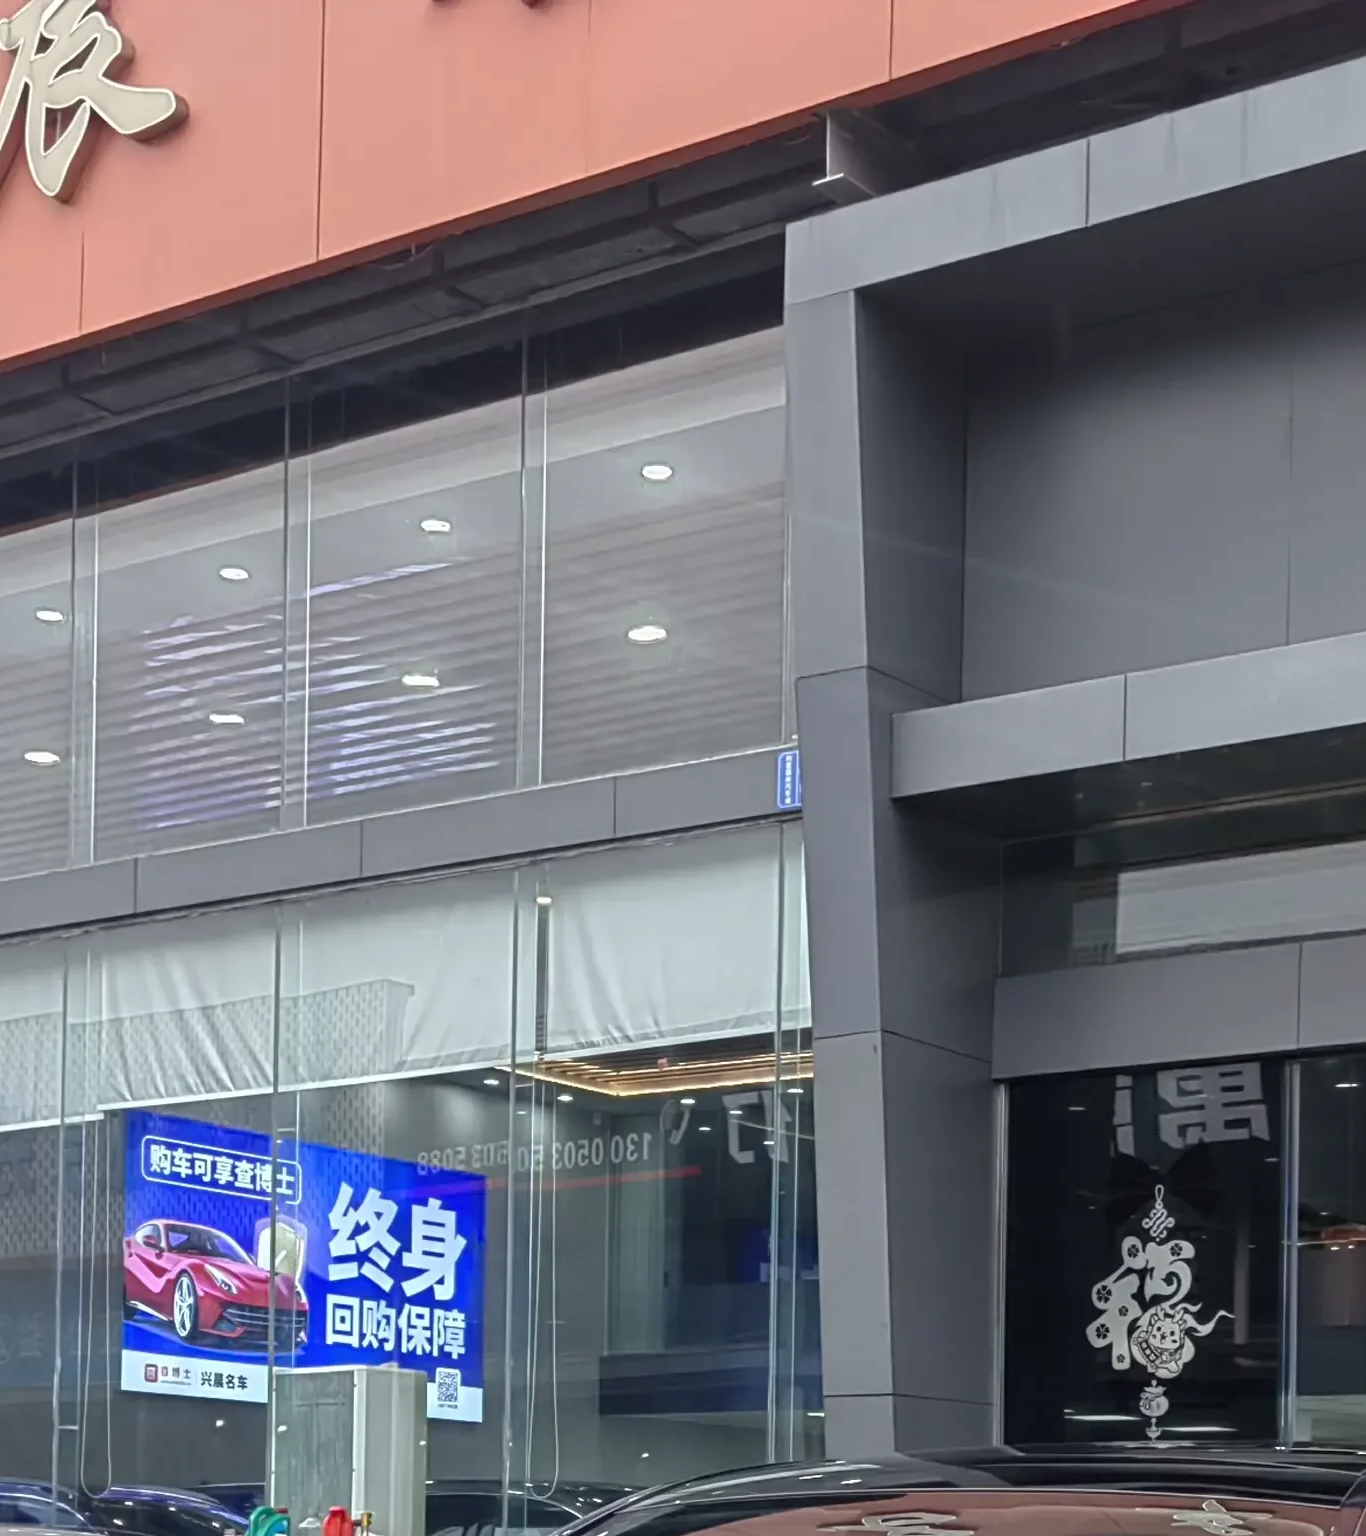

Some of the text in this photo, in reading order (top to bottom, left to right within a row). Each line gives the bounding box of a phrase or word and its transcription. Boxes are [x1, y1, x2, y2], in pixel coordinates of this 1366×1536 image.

[149, 1143, 296, 1196] 购车可享查博士
[327, 1181, 468, 1301] 终身
[325, 1293, 467, 1360] 回购保障
[200, 1370, 249, 1391] 兴晨名车
